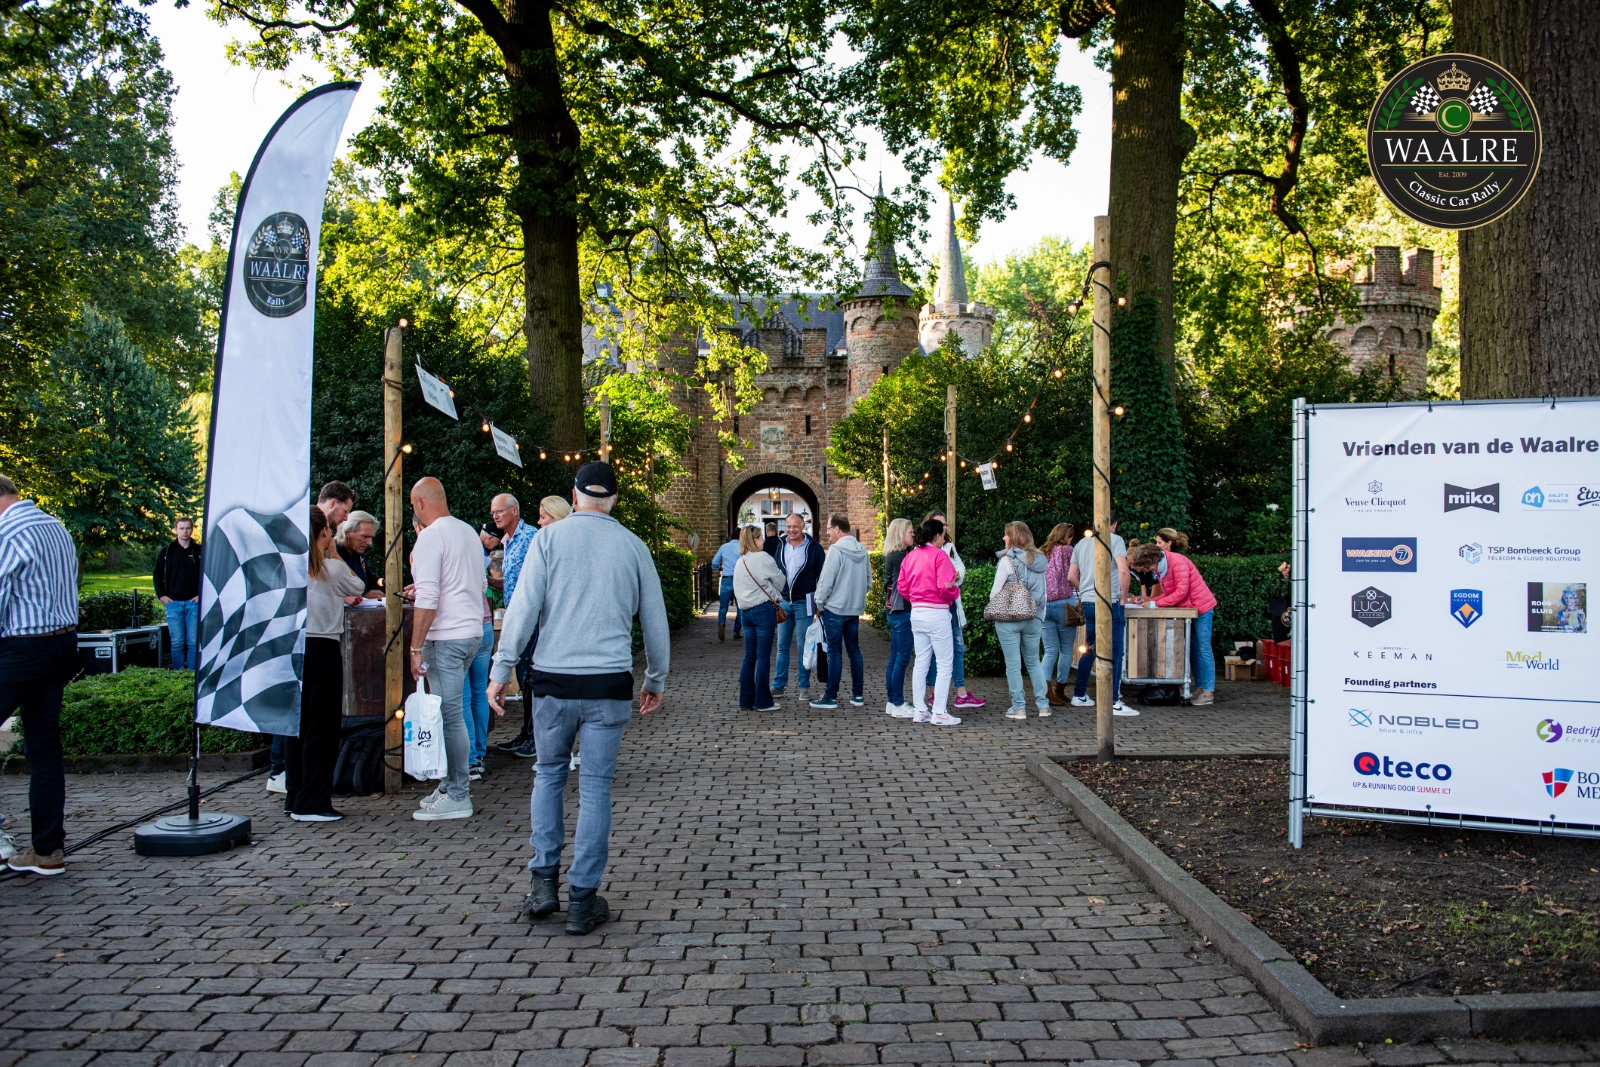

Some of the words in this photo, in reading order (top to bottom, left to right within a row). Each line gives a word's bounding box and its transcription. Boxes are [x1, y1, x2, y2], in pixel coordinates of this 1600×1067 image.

[266, 296, 286, 306] Rally
[1342, 440, 1436, 456] Vrienden
[1442, 442, 1480, 454] van
[1486, 438, 1514, 454] de
[1520, 436, 1600, 453] Waalre
[1345, 498, 1369, 506] Veuve
[1371, 497, 1406, 508] Clicquot
[1448, 492, 1494, 504] miko
[1507, 546, 1552, 554] Bombeeck
[1554, 547, 1581, 556] Group
[1354, 601, 1389, 612] LUCA
[1354, 651, 1432, 660] KEEMAN
[1505, 651, 1542, 662] Med
[1526, 659, 1559, 670] World
[1344, 678, 1391, 688] Founding
[1393, 680, 1437, 689] partners
[1379, 715, 1479, 730] NOBLEO
[1354, 752, 1452, 781] Qteco
[1577, 772, 1600, 784] BO
[1577, 786, 1600, 799] ME
